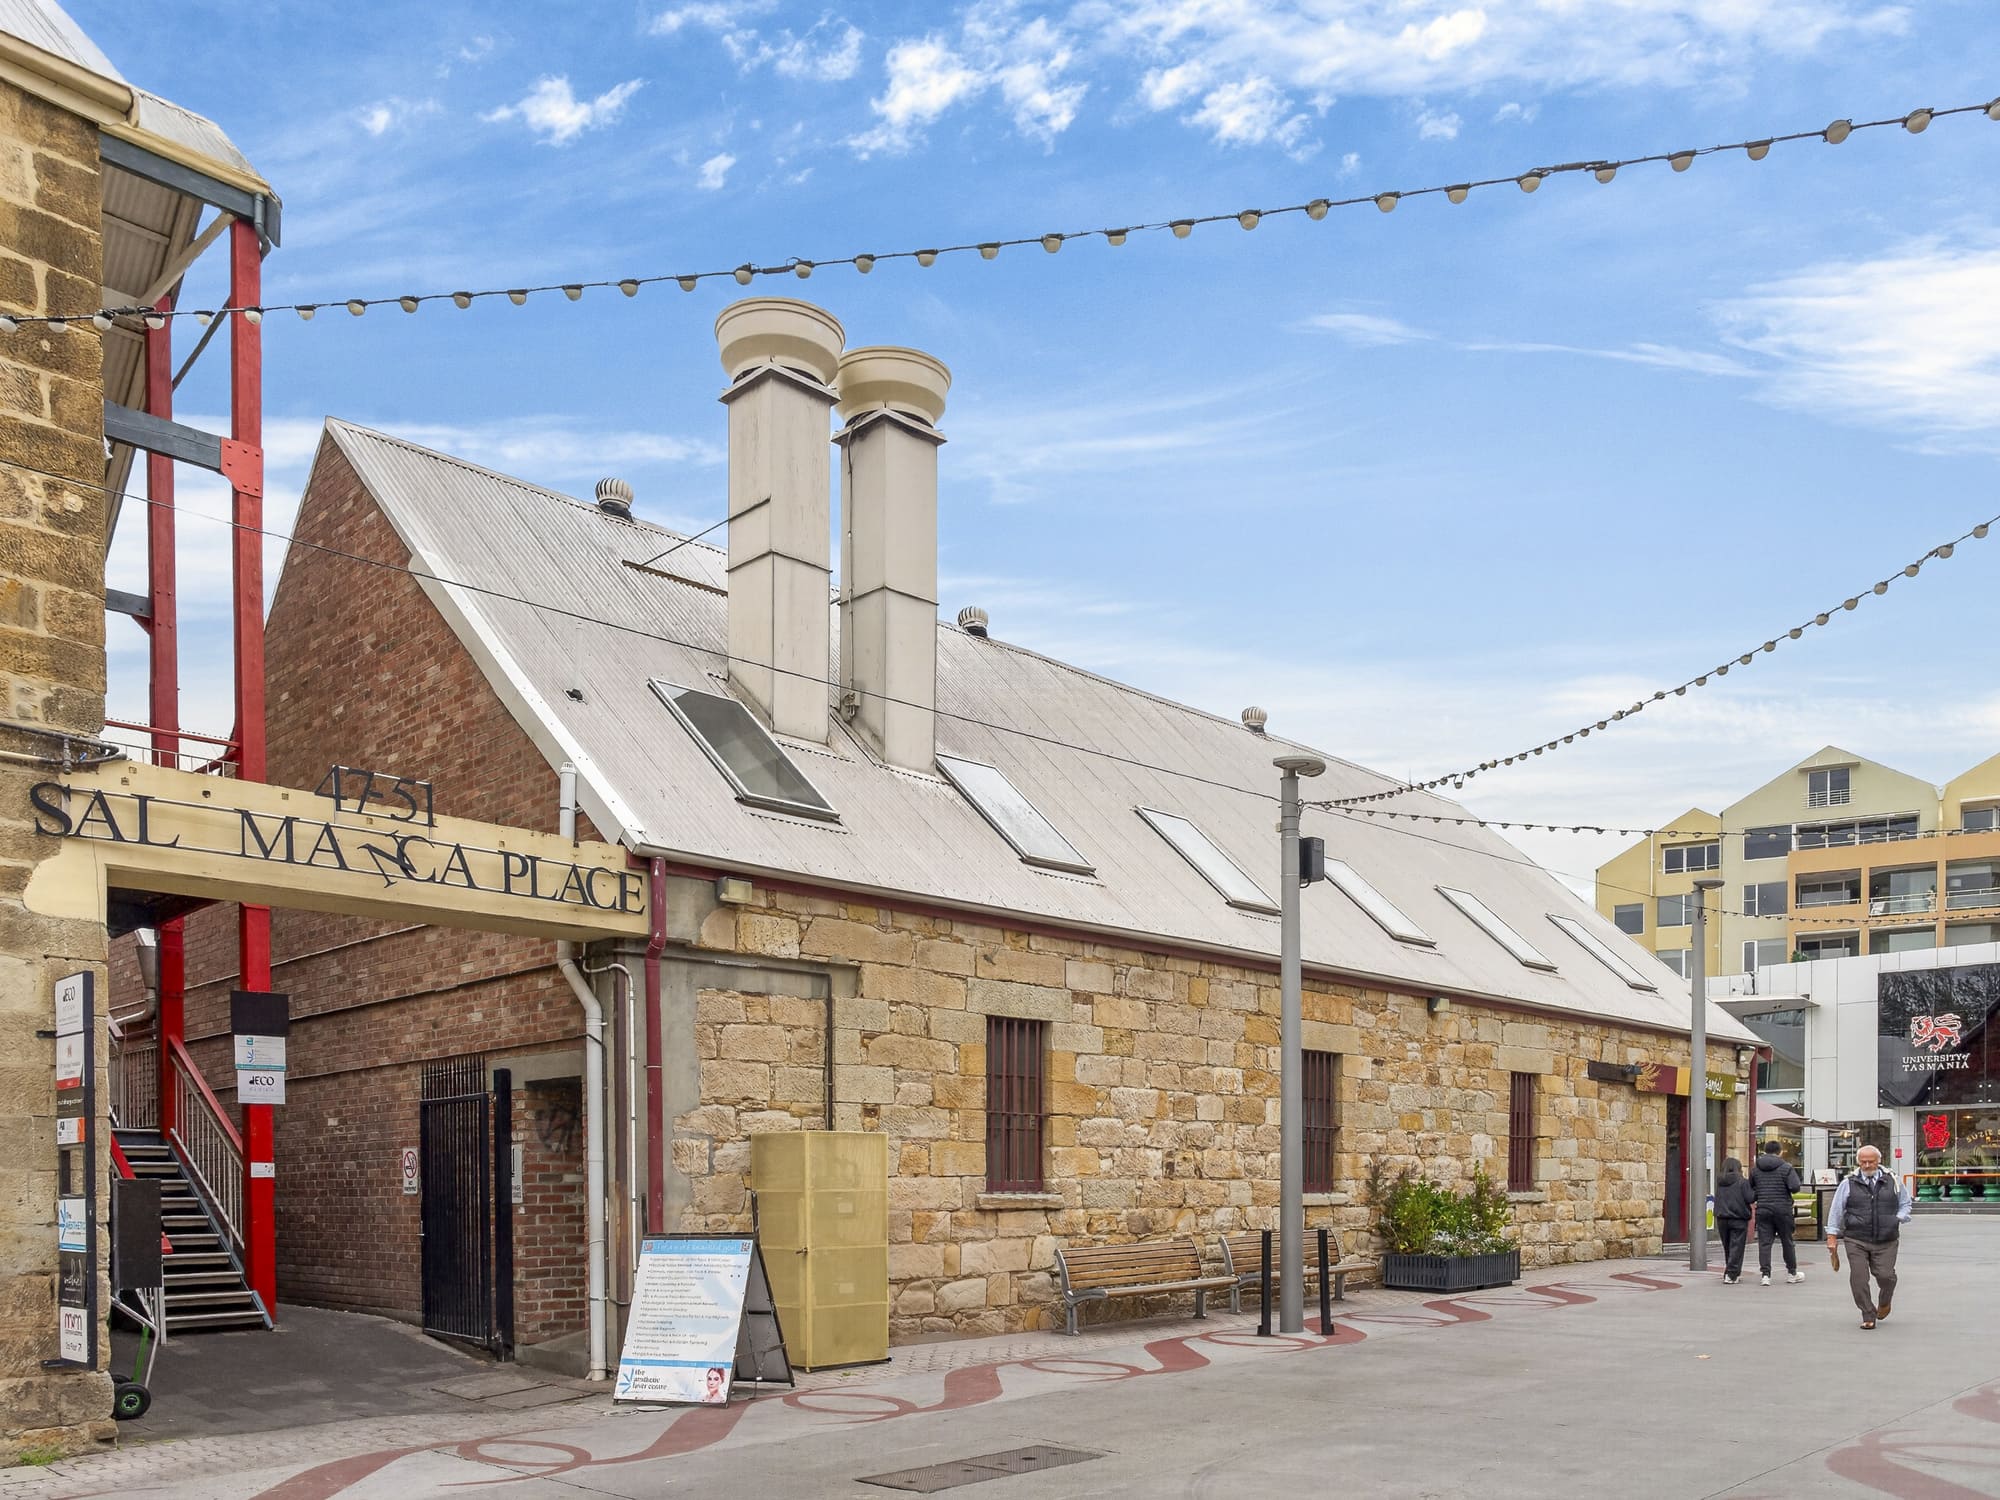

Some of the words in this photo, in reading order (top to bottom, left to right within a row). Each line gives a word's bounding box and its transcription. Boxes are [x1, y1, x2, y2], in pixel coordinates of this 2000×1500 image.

[314, 764, 437, 828] 47-51
[497, 849, 646, 916] PLACE
[1902, 1053, 1962, 1064] UNIVERSITY
[1961, 1053, 1971, 1061] of
[1902, 1062, 1969, 1072] TASMANIA
